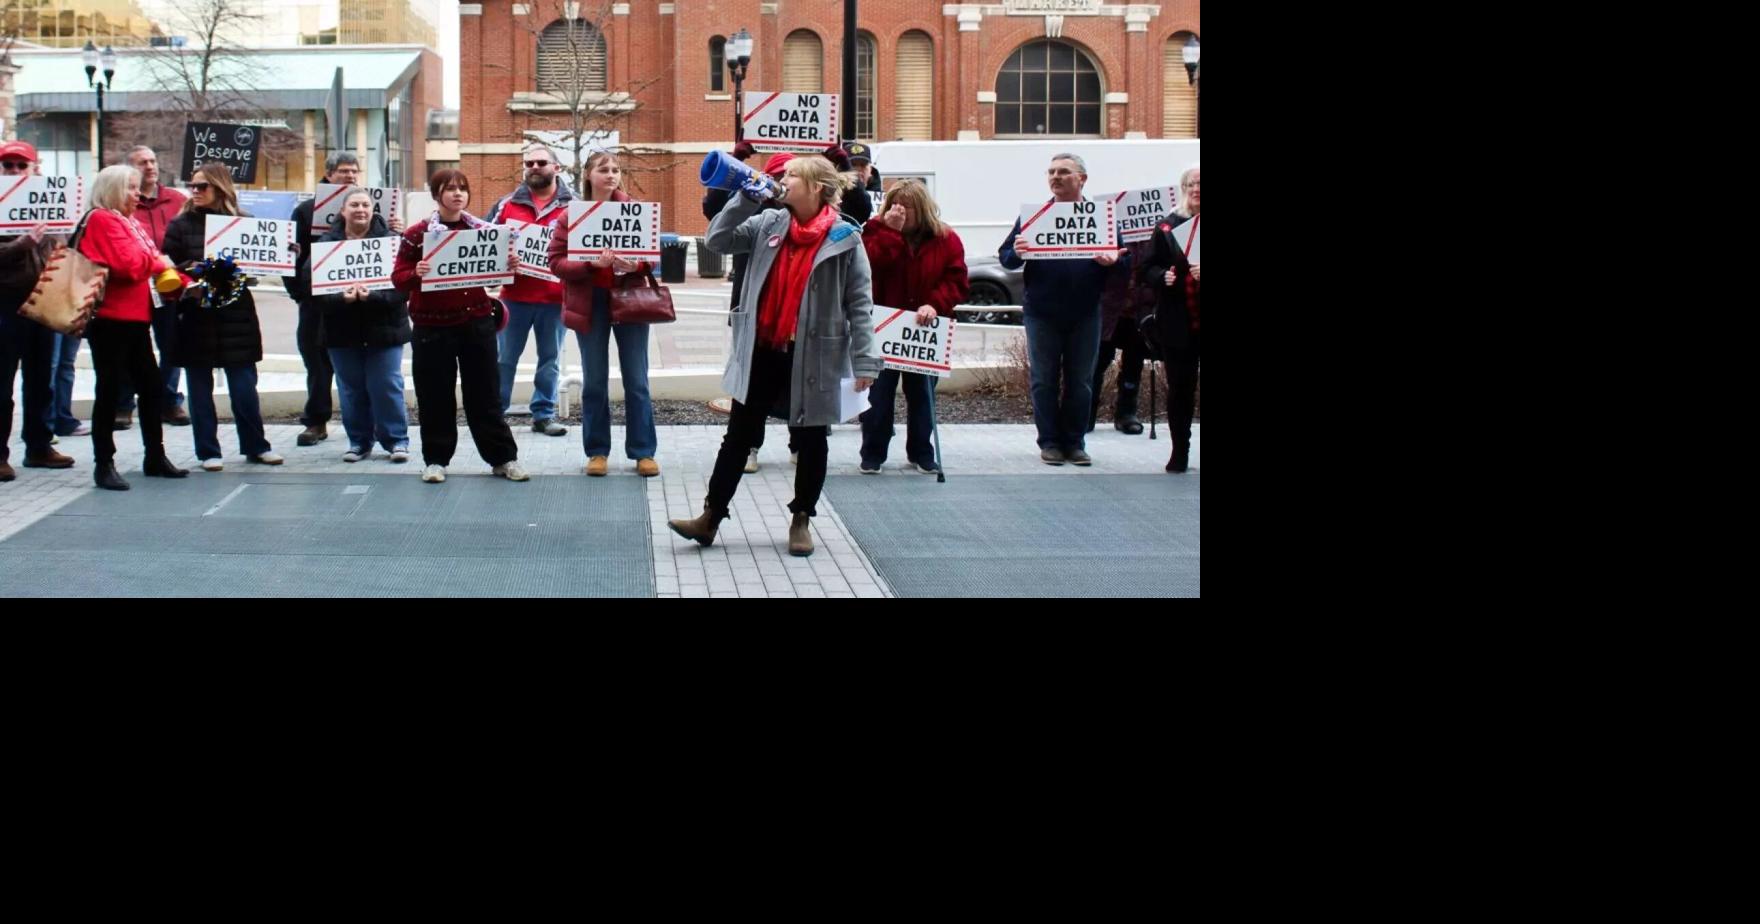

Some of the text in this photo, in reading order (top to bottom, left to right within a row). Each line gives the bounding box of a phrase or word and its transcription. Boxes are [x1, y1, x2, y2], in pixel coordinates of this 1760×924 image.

[798, 94, 820, 108] NO
[778, 109, 820, 124] DATA
[192, 126, 217, 142] We
[757, 124, 823, 140] CENTER.
[194, 142, 252, 160] Deserve
[47, 176, 67, 188] NO
[29, 191, 67, 204] DATA
[1140, 189, 1161, 202] NO
[8, 207, 70, 221] CENTER.
[620, 203, 642, 216] NO
[1073, 202, 1096, 214] NO
[1127, 202, 1164, 216] DATA
[258, 220, 277, 233] NO
[602, 218, 642, 232] DATA
[1055, 217, 1097, 230] DATA
[241, 234, 278, 248] DATA
[477, 228, 499, 242] NO
[582, 234, 646, 249] CENTER.
[1035, 232, 1102, 246] CENTER.
[361, 240, 381, 251] NO
[458, 244, 498, 258] DATA
[525, 237, 550, 252] DAT
[221, 247, 281, 262] CENTER.
[345, 253, 382, 265] DATA
[517, 250, 550, 268] ENTER
[327, 266, 387, 281] CENTER.
[437, 260, 500, 276] CENTER.
[902, 327, 938, 345] DATA
[881, 341, 939, 362] CENTER.
